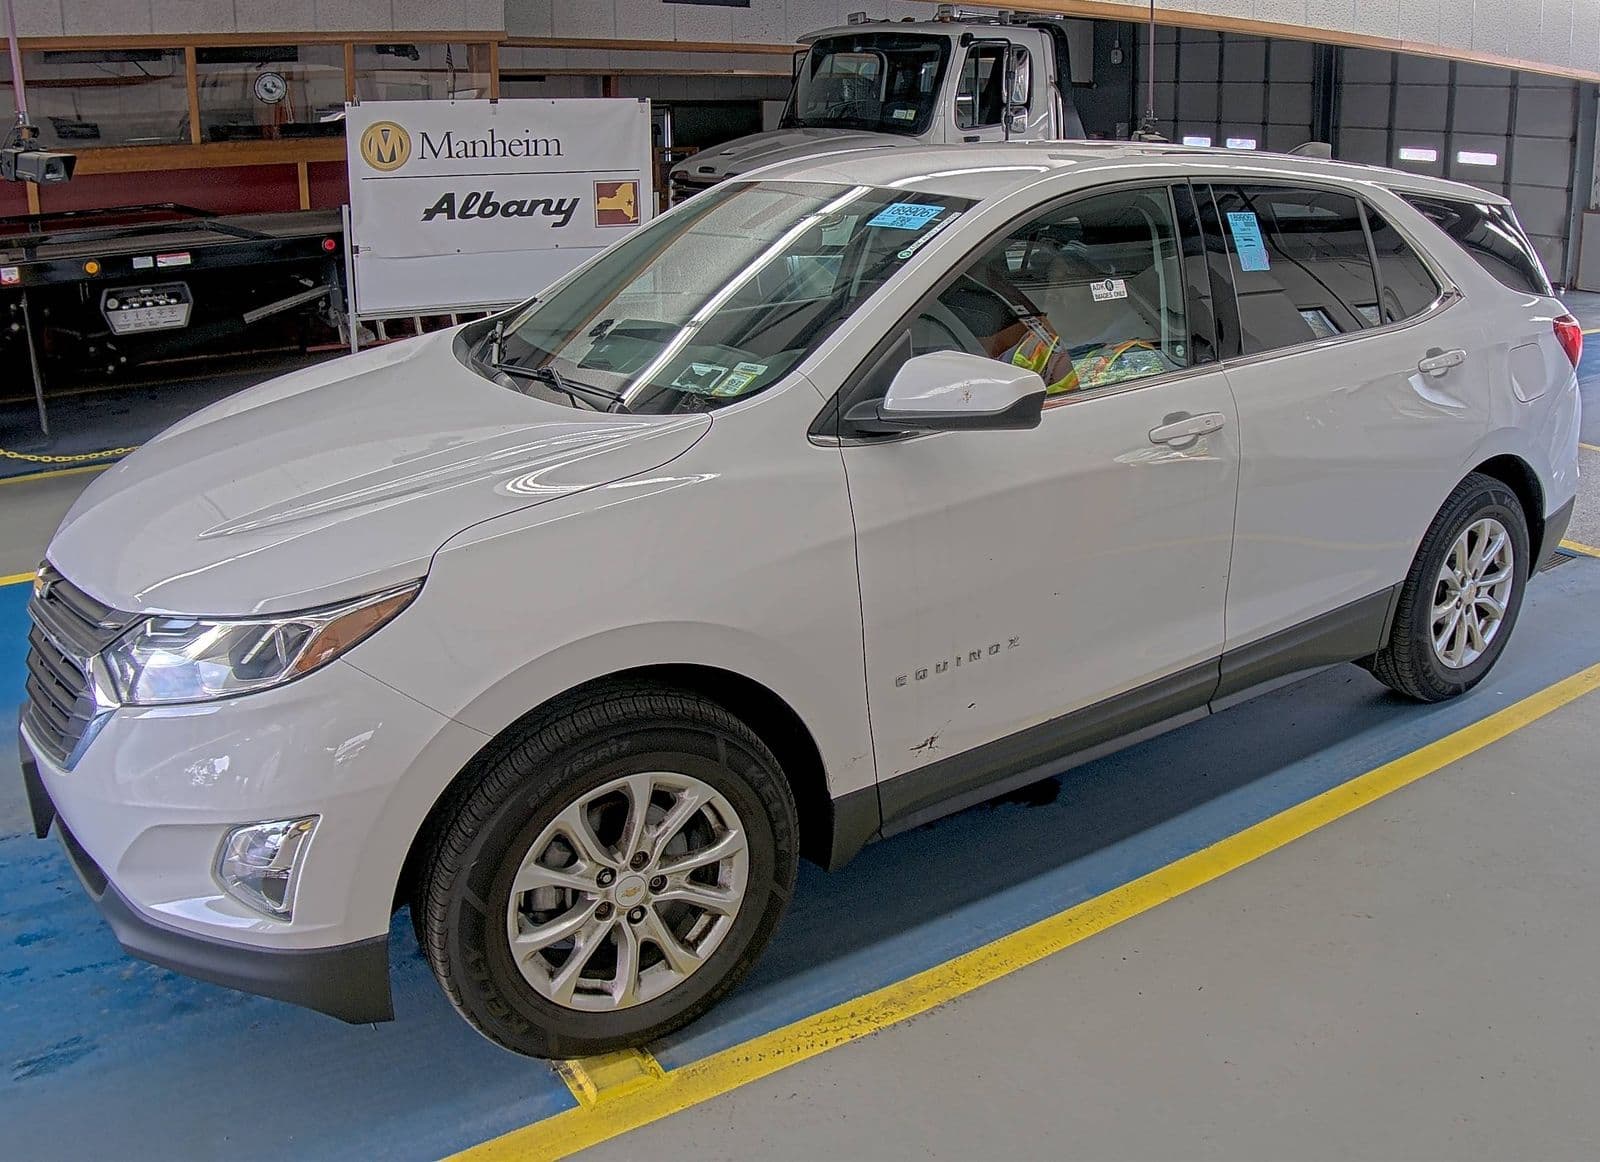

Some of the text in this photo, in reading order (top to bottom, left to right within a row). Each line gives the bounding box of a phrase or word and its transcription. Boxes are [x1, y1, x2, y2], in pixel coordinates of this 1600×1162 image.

[418, 128, 564, 160] Manheim
[420, 190, 581, 228] Albany
[895, 636, 1020, 687] EQUINOX
